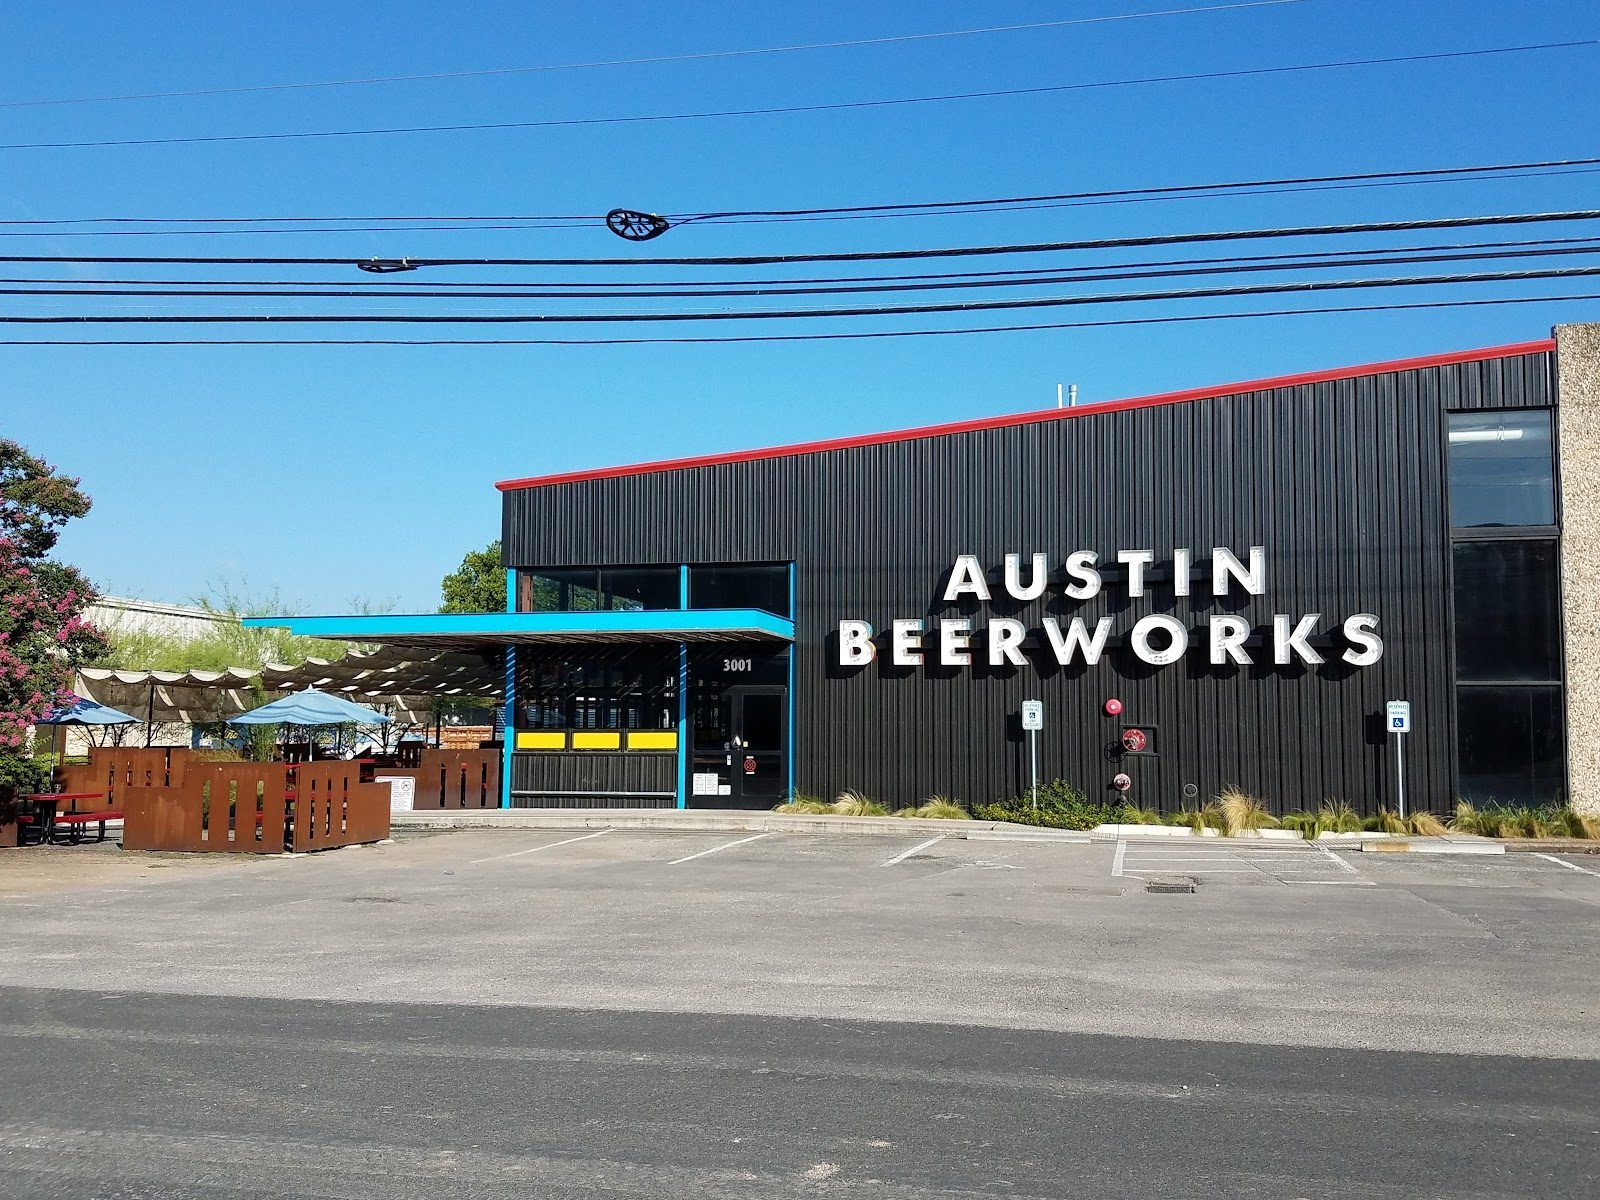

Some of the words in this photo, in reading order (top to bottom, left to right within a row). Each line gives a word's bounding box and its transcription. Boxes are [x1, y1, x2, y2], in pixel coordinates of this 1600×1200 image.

[943, 546, 1265, 601] AUSTIN
[723, 658, 752, 672] 3001
[838, 613, 1384, 666] BEERWORKS
